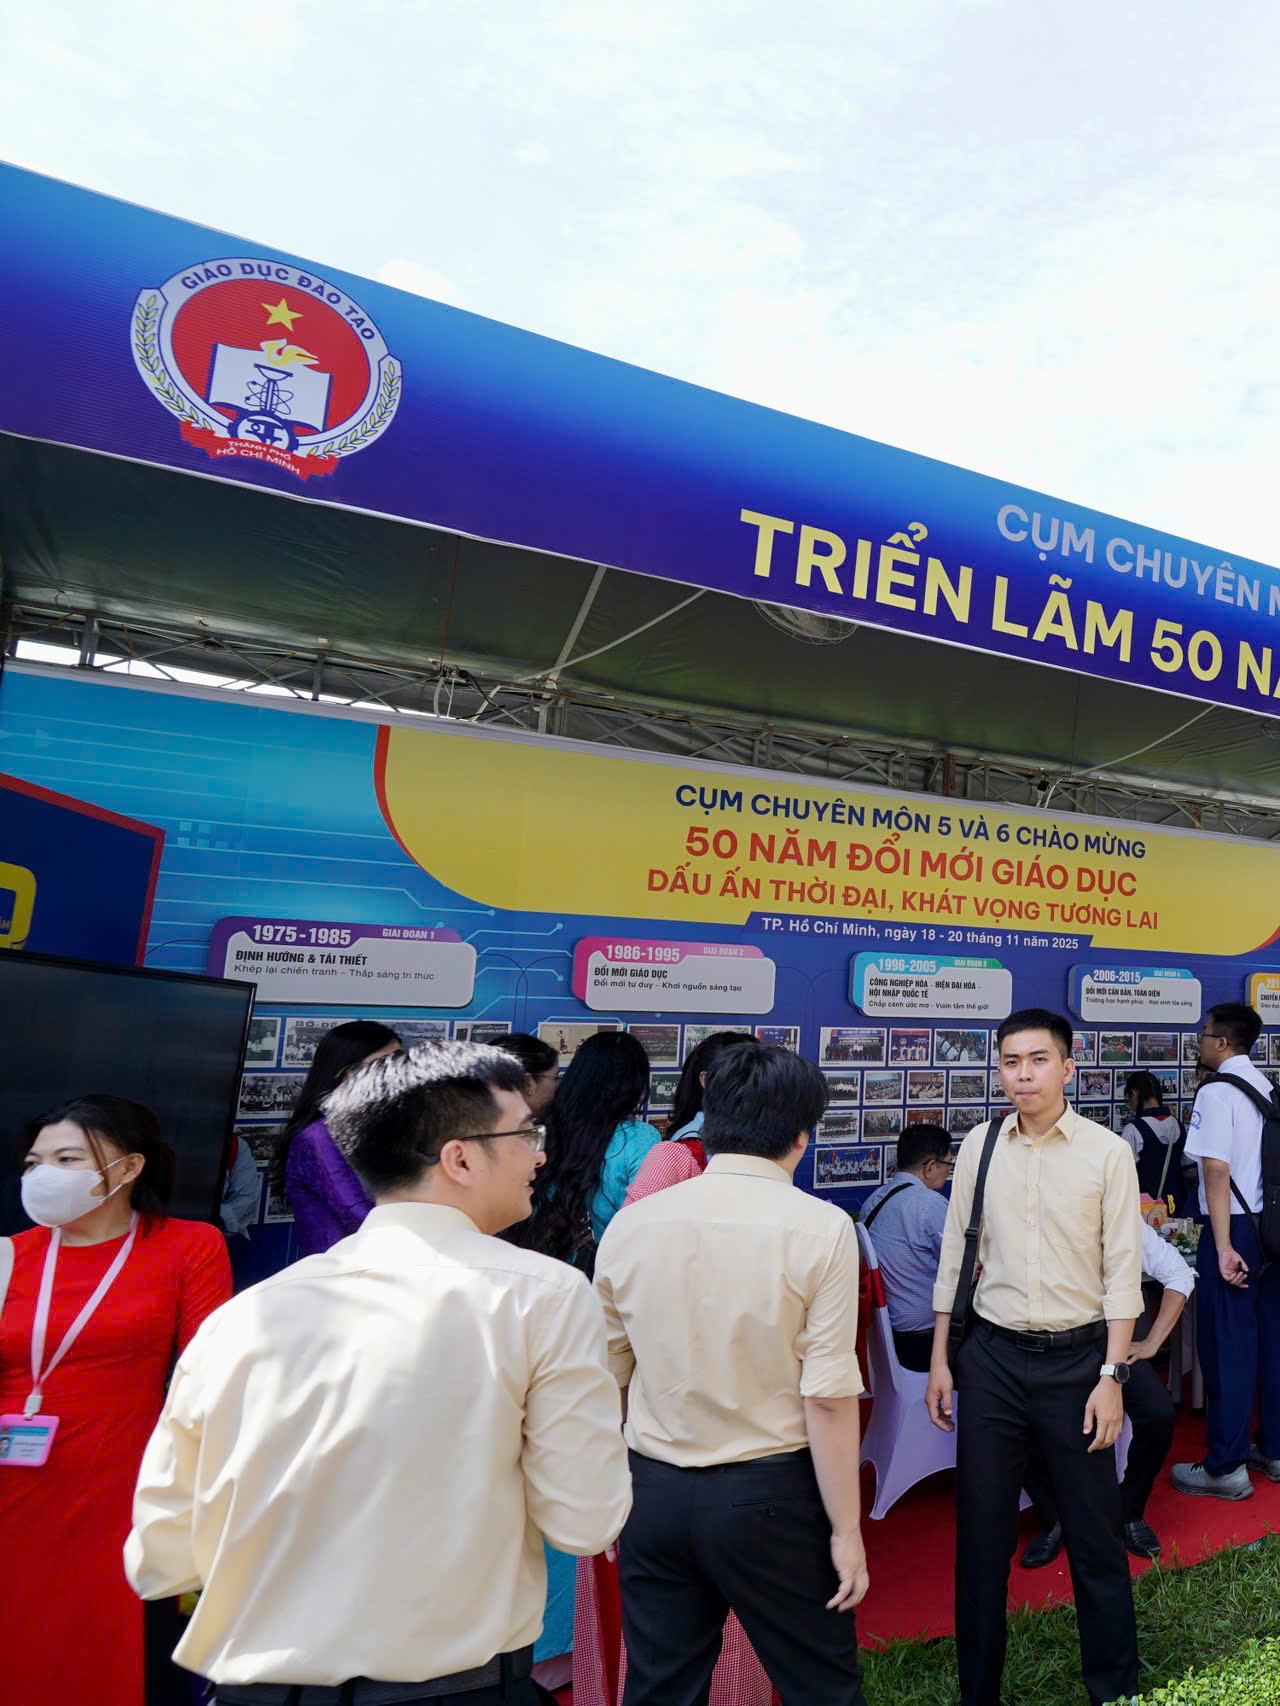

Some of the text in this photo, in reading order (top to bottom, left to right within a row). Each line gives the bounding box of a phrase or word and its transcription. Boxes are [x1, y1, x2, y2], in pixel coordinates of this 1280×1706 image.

[181, 263, 232, 290] GIÁO
[239, 262, 290, 281] DỤC
[347, 305, 375, 341] TẠO
[228, 441, 268, 454] THÀNH
[240, 450, 264, 460] CHÍ
[266, 454, 302, 474] MINH
[997, 504, 1095, 564] CỤM
[1106, 536, 1260, 612] CHUYÊN
[740, 508, 973, 624] TRIỂN
[991, 573, 1134, 663] LÃM
[1150, 618, 1223, 682] 50
[676, 784, 1146, 859] CỤM CHUYÊN MÔN 5 VÀ 6 CHÀO MỪNG
[685, 825, 1137, 902] 50 NĂM ĐỔI MỚI GIÁO DỤC
[647, 861, 1158, 930] DẤU ẤN THỜI ĐẠI, KHÁT VỌNG TƯƠNG LAI
[382, 928, 435, 941] GIAI ĐOẠN 1
[761, 917, 784, 932] TP.
[789, 918, 810, 933] Hồ
[813, 920, 838, 935] Chí
[842, 922, 880, 939] Minh,
[884, 927, 917, 942] ngày
[921, 928, 936, 941] 18
[947, 930, 963, 943] 20
[966, 932, 1002, 948] tháng
[1006, 934, 1019, 946] 11
[1023, 935, 1049, 948] năm
[1052, 937, 1079, 950] 2025
[235, 949, 368, 966] ĐỊNH HƯỚNG & TÁI THIẾT
[606, 944, 680, 962] 1986-1995
[234, 964, 262, 976] Khép
[265, 965, 278, 975] lại
[280, 965, 309, 975] chiến
[312, 967, 337, 977] tranh
[377, 969, 400, 980] sáng
[402, 971, 412, 979] tri
[414, 971, 435, 980] thức
[594, 965, 668, 980] ĐỔI MỚI GIÁO DỤC
[879, 958, 937, 973] 1996-2005
[1093, 969, 1141, 983] 2006-2015
[610, 980, 626, 988] mới
[628, 980, 636, 988] tư
[638, 980, 653, 990] duy
[662, 981, 680, 989] Khơi
[683, 981, 707, 991] nguồn
[709, 983, 728, 993] sáng
[730, 984, 742, 993] tạo
